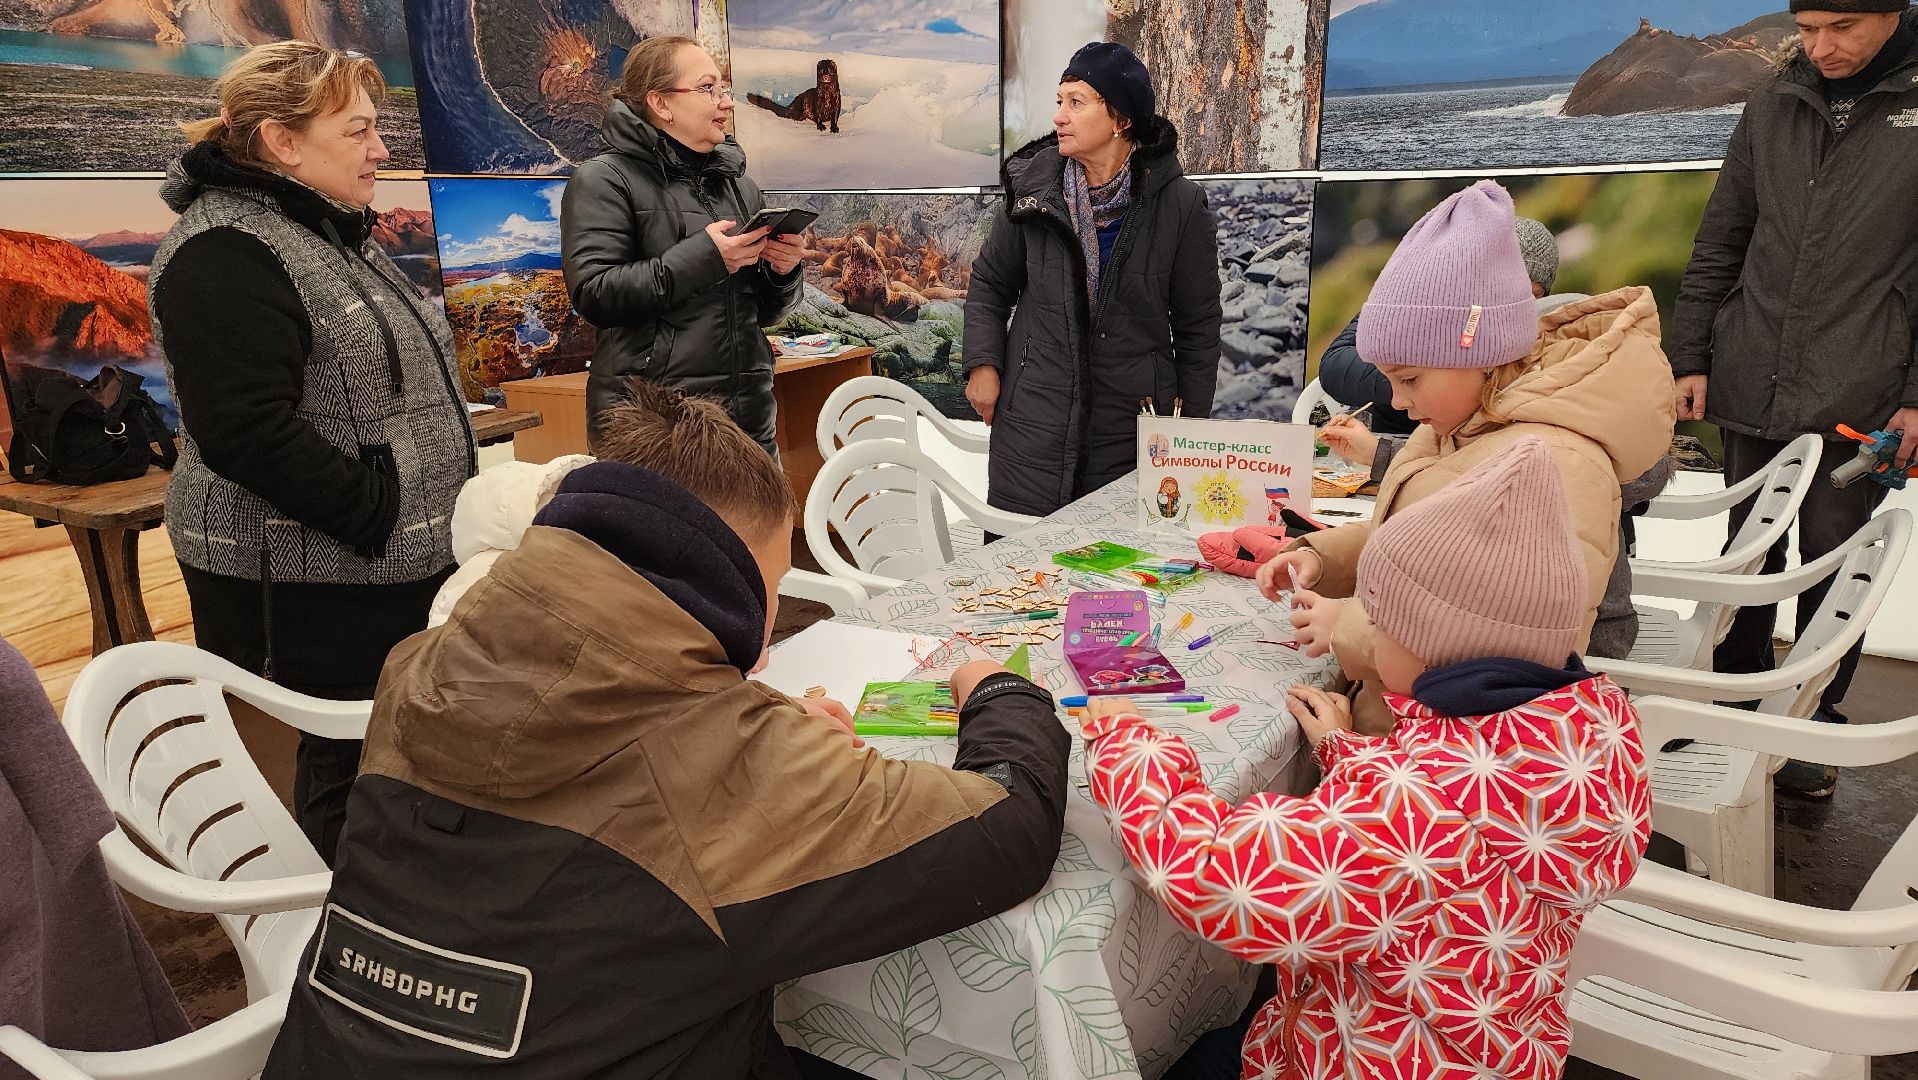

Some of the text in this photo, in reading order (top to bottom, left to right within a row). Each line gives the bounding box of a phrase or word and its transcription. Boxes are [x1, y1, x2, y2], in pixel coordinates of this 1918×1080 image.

[1173, 436, 1272, 454] Мастер-класс
[1151, 454, 1292, 478] Символы России
[339, 947, 479, 1014] SRHBDPHG
